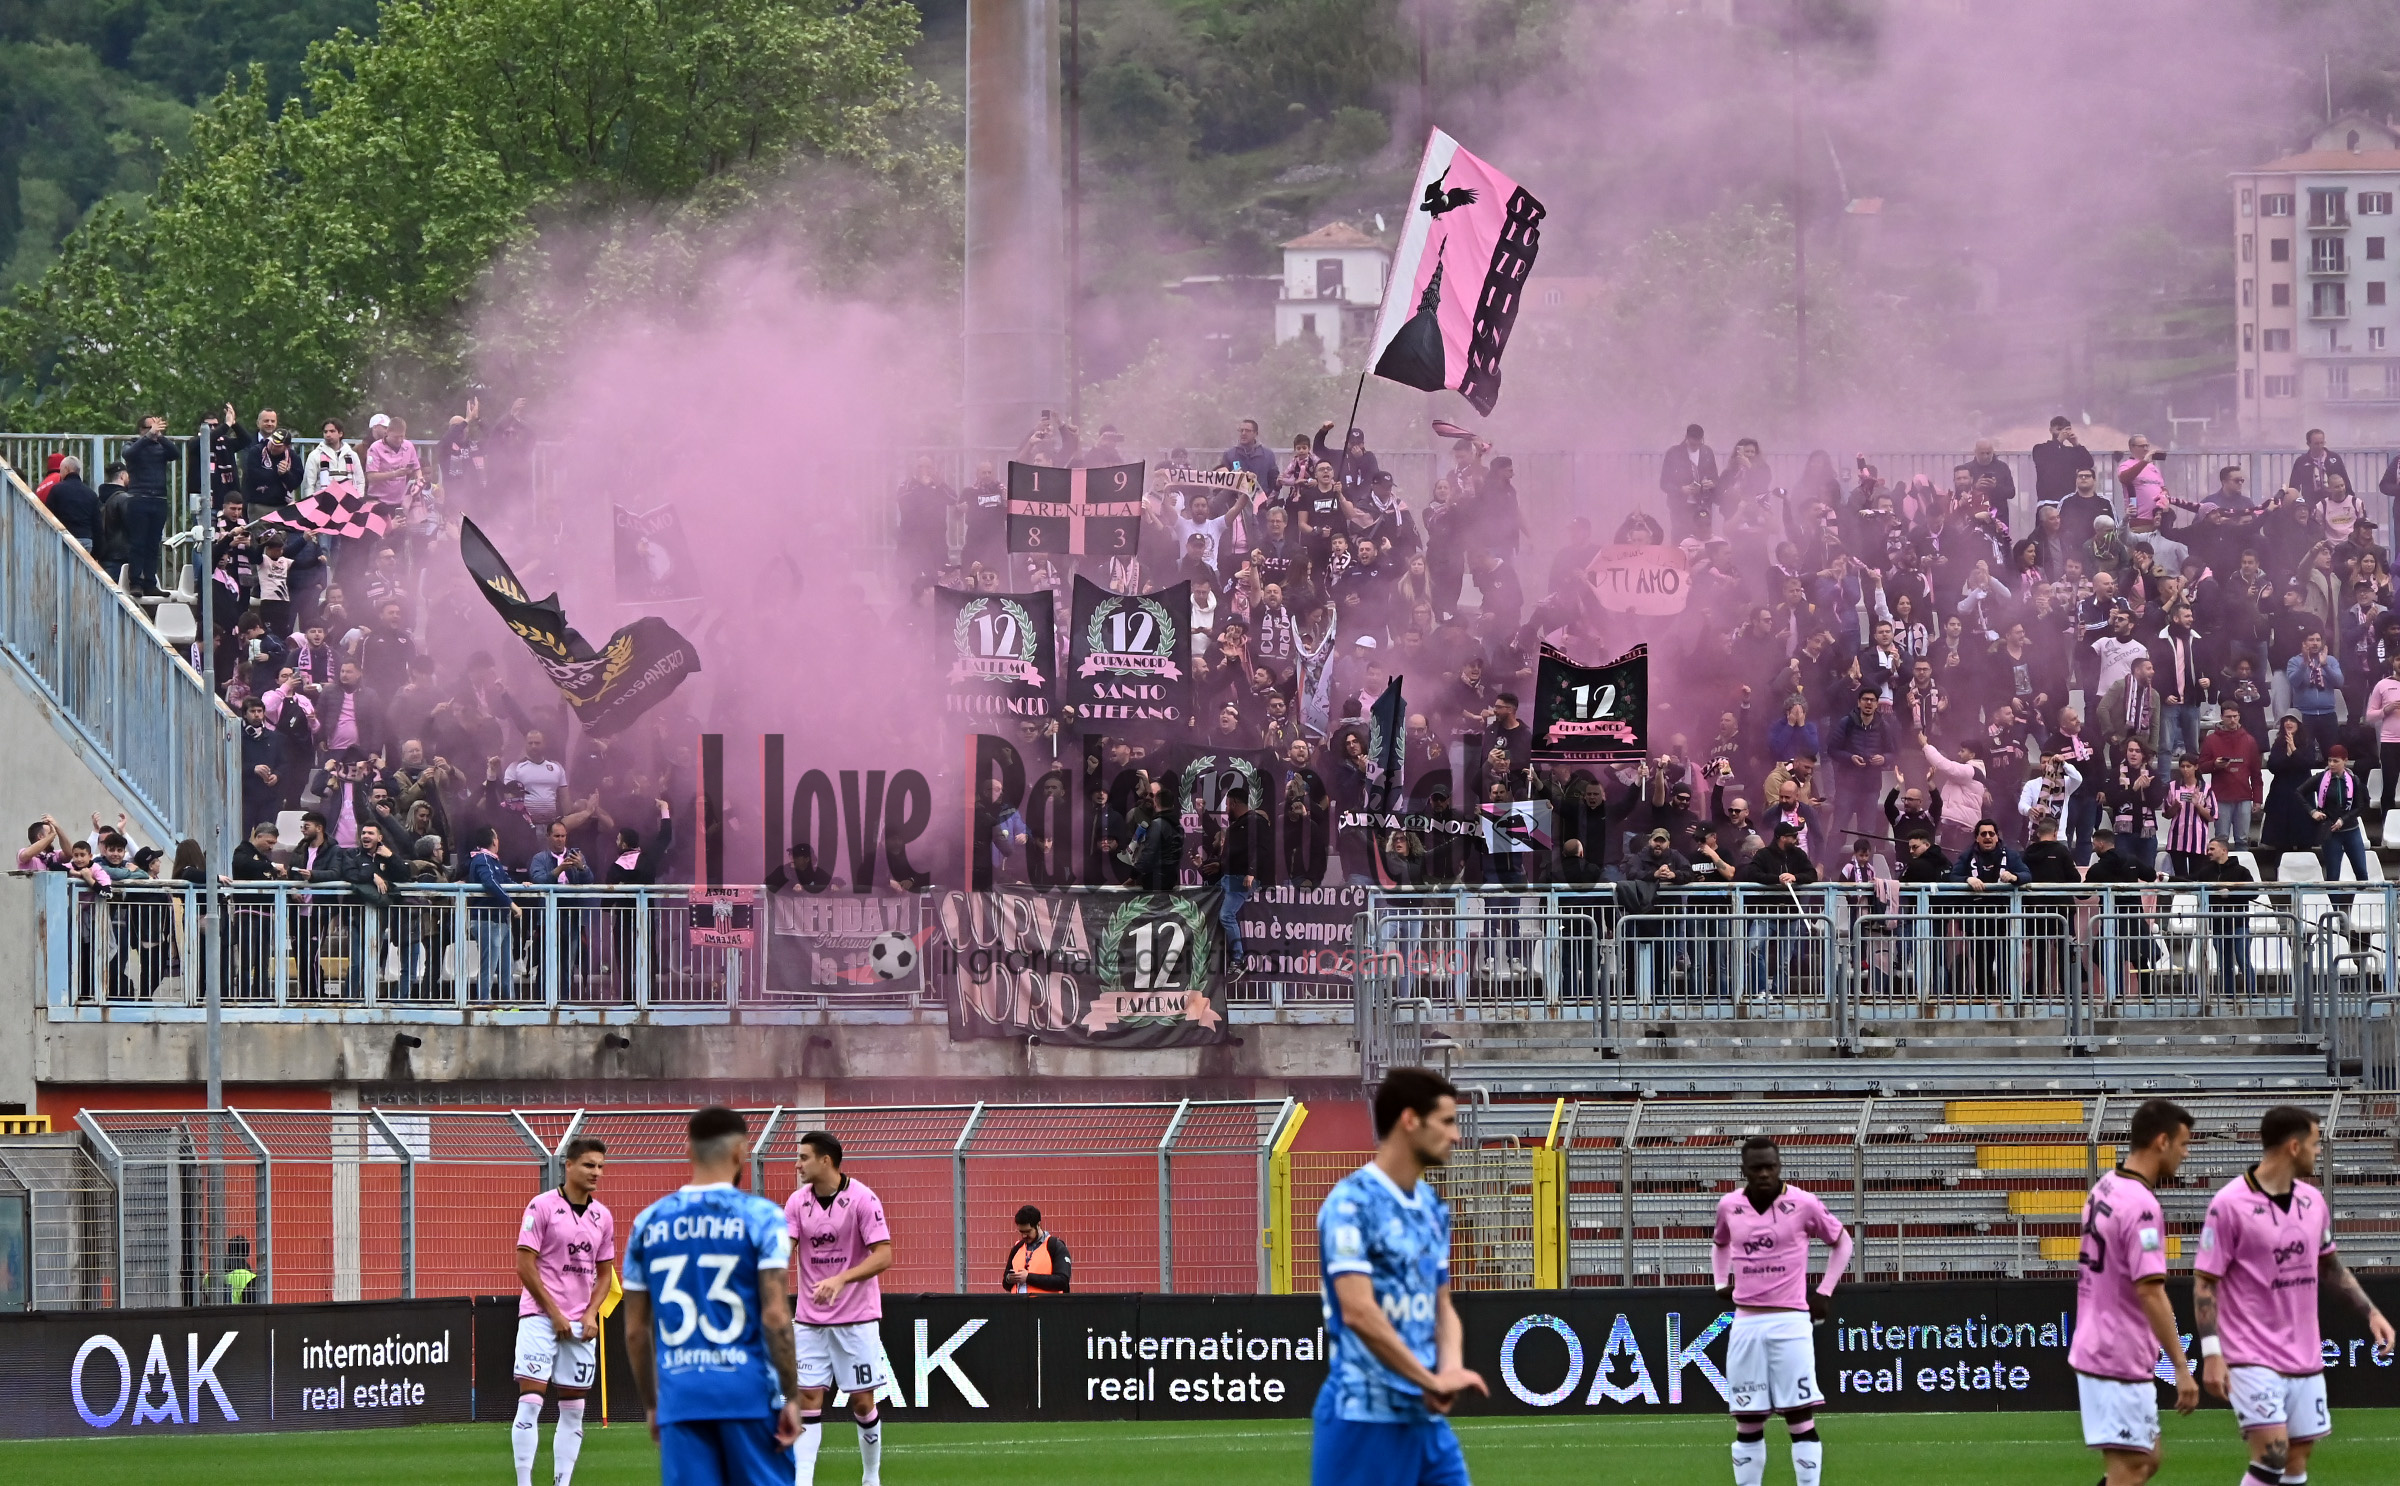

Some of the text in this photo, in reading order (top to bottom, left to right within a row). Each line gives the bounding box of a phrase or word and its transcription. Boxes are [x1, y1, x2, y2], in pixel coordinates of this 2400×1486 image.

[1114, 471, 1128, 492] 9
[1169, 468, 1236, 487] PALERMO
[1023, 502, 1134, 517] ARENELLA
[1028, 527, 1127, 548] 8 3
[1607, 567, 1680, 595] TI AMO
[974, 613, 1019, 657] 12
[1108, 611, 1154, 653] 12
[1093, 655, 1167, 669] CURVA NORD
[1093, 682, 1167, 701] SANTO
[1571, 684, 1617, 719] 12
[1006, 697, 1050, 717] NORD
[1077, 703, 1181, 721] STEFANO
[1558, 723, 1623, 733] CURVA NORD
[1199, 770, 1244, 812] 12
[1338, 812, 1401, 832] CURVA
[1265, 884, 1295, 905] chi
[1299, 884, 1337, 906] non
[1340, 884, 1365, 907] c'è
[774, 896, 911, 933] DIFFIDATI
[939, 890, 1092, 962] CURVA
[1270, 915, 1282, 940] è
[1284, 919, 1355, 945] sempre
[1127, 921, 1187, 990] 12
[1246, 951, 1318, 975] on noi
[956, 960, 1081, 1032] NORD
[1115, 993, 1190, 1014] PALERMO
[1836, 1037, 1849, 1048] 22
[1895, 1038, 1907, 1048] 23
[1867, 1080, 1880, 1091] 22
[642, 1214, 746, 1249] DA CUNHA
[810, 1255, 848, 1266] Bisaten
[1884, 1261, 1899, 1272] 20
[1940, 1261, 1953, 1271] 21
[1993, 1261, 2007, 1271] 22
[2046, 1260, 2059, 1270] 23
[648, 1253, 747, 1348] 33
[1086, 1325, 1325, 1363] international
[1837, 1311, 2069, 1353] international
[302, 1330, 450, 1370] international
[1500, 1312, 1735, 1407] OAK
[71, 1331, 240, 1429] OAK
[574, 1361, 595, 1384] 37
[852, 1363, 873, 1386] 18
[1838, 1360, 2031, 1394] real estate
[302, 1376, 426, 1411] real estate
[1086, 1372, 1287, 1404] real estate
[1797, 1376, 1812, 1400] 5
